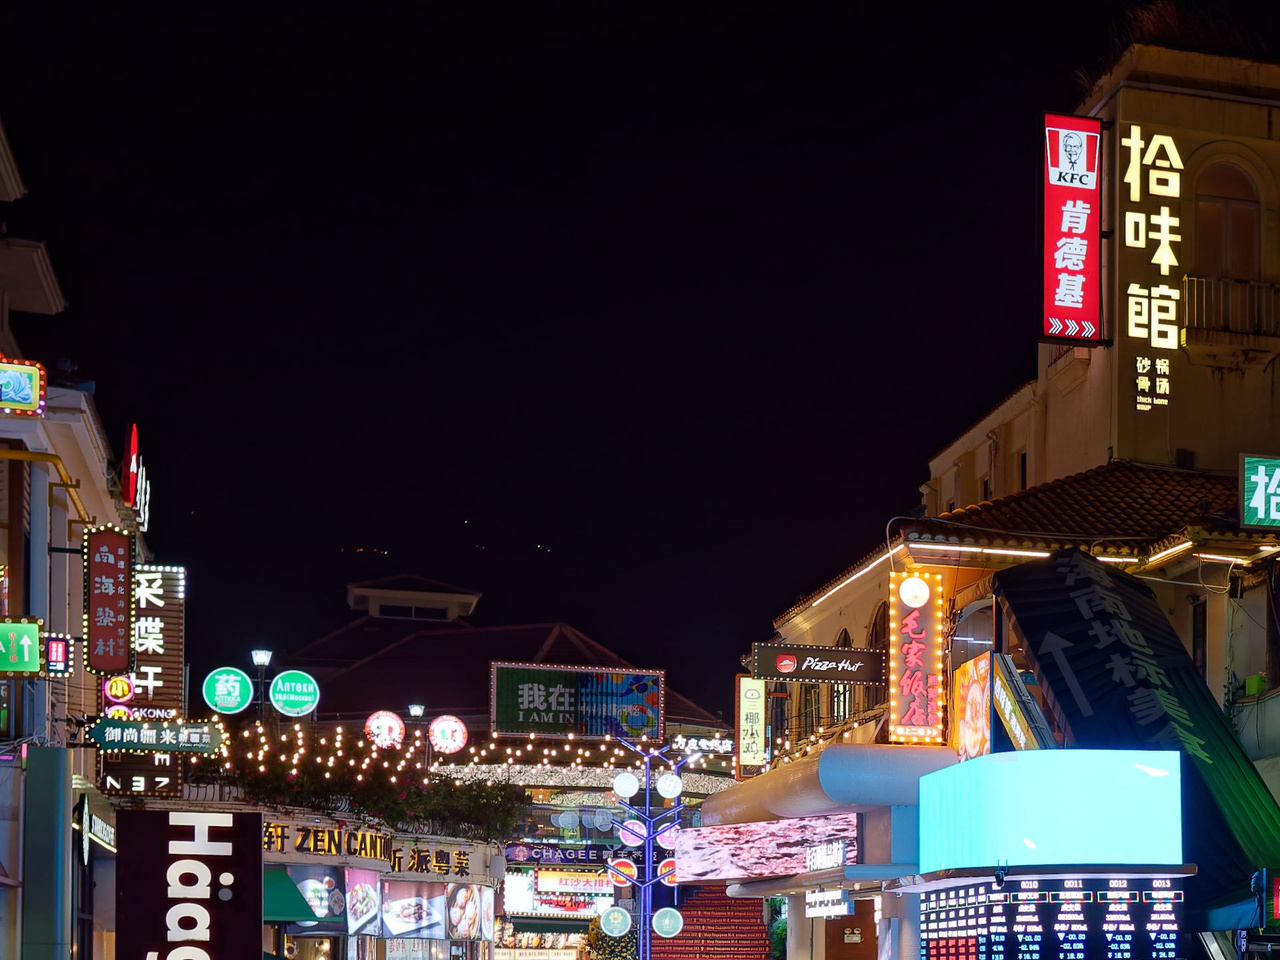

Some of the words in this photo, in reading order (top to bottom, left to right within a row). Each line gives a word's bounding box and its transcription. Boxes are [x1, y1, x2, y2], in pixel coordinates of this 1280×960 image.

[1056, 171, 1089, 186] KFC
[1053, 200, 1091, 308] 肯德基
[801, 656, 837, 671] Pizza
[838, 659, 865, 673] Hut
[900, 608, 927, 726] 毛家饭店
[214, 673, 242, 696] 药
[276, 679, 315, 694] Аптеки
[518, 683, 575, 711] 我在
[518, 712, 525, 722] I
[528, 713, 555, 723] AM
[558, 714, 575, 724] IN
[296, 826, 343, 855] ZEN
[531, 849, 598, 861] CHAGEE
[1020, 880, 1038, 889] 0010
[1064, 880, 1083, 889] 0011
[1109, 880, 1127, 889] 0012
[1153, 880, 1171, 889] 0013
